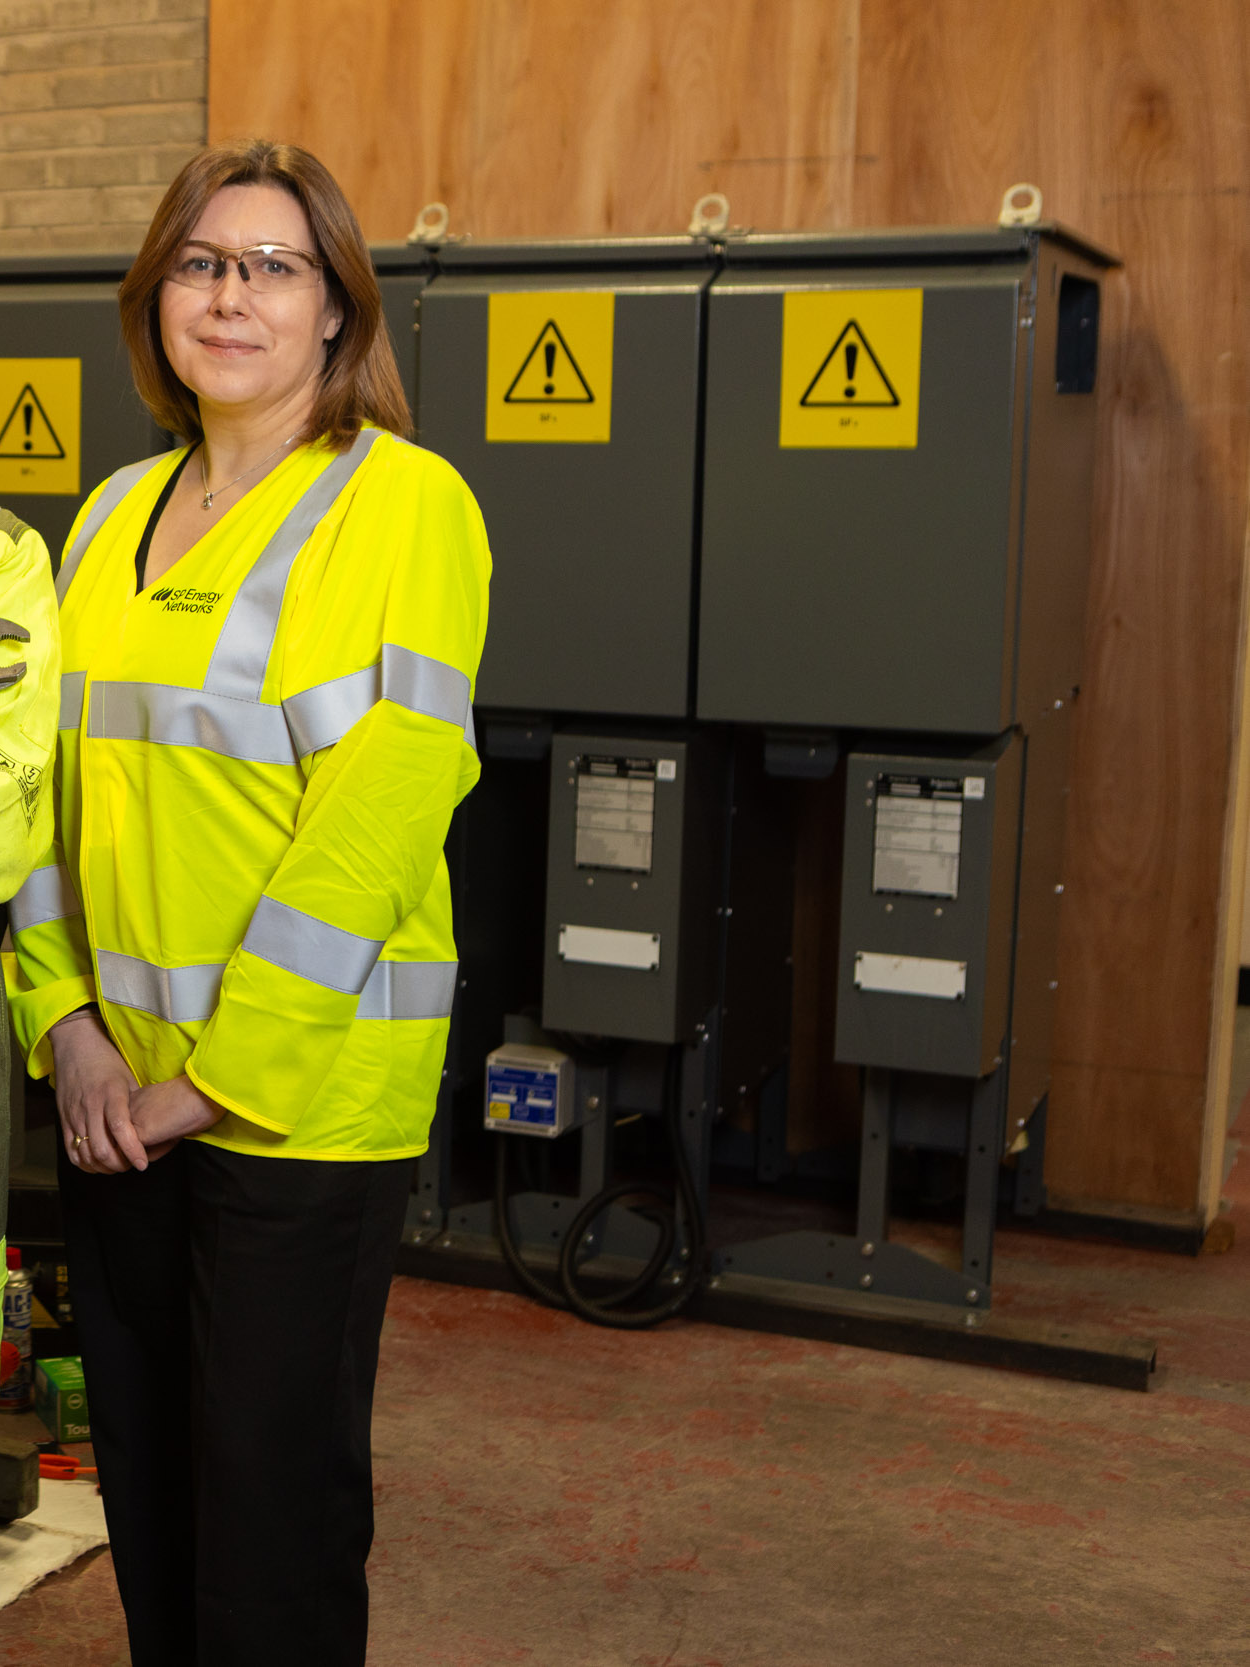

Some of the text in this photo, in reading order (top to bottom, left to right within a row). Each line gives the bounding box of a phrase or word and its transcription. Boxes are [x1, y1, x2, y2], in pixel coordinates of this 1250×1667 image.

[170, 588, 224, 604] SP Energy
[161, 601, 214, 614] Networks
